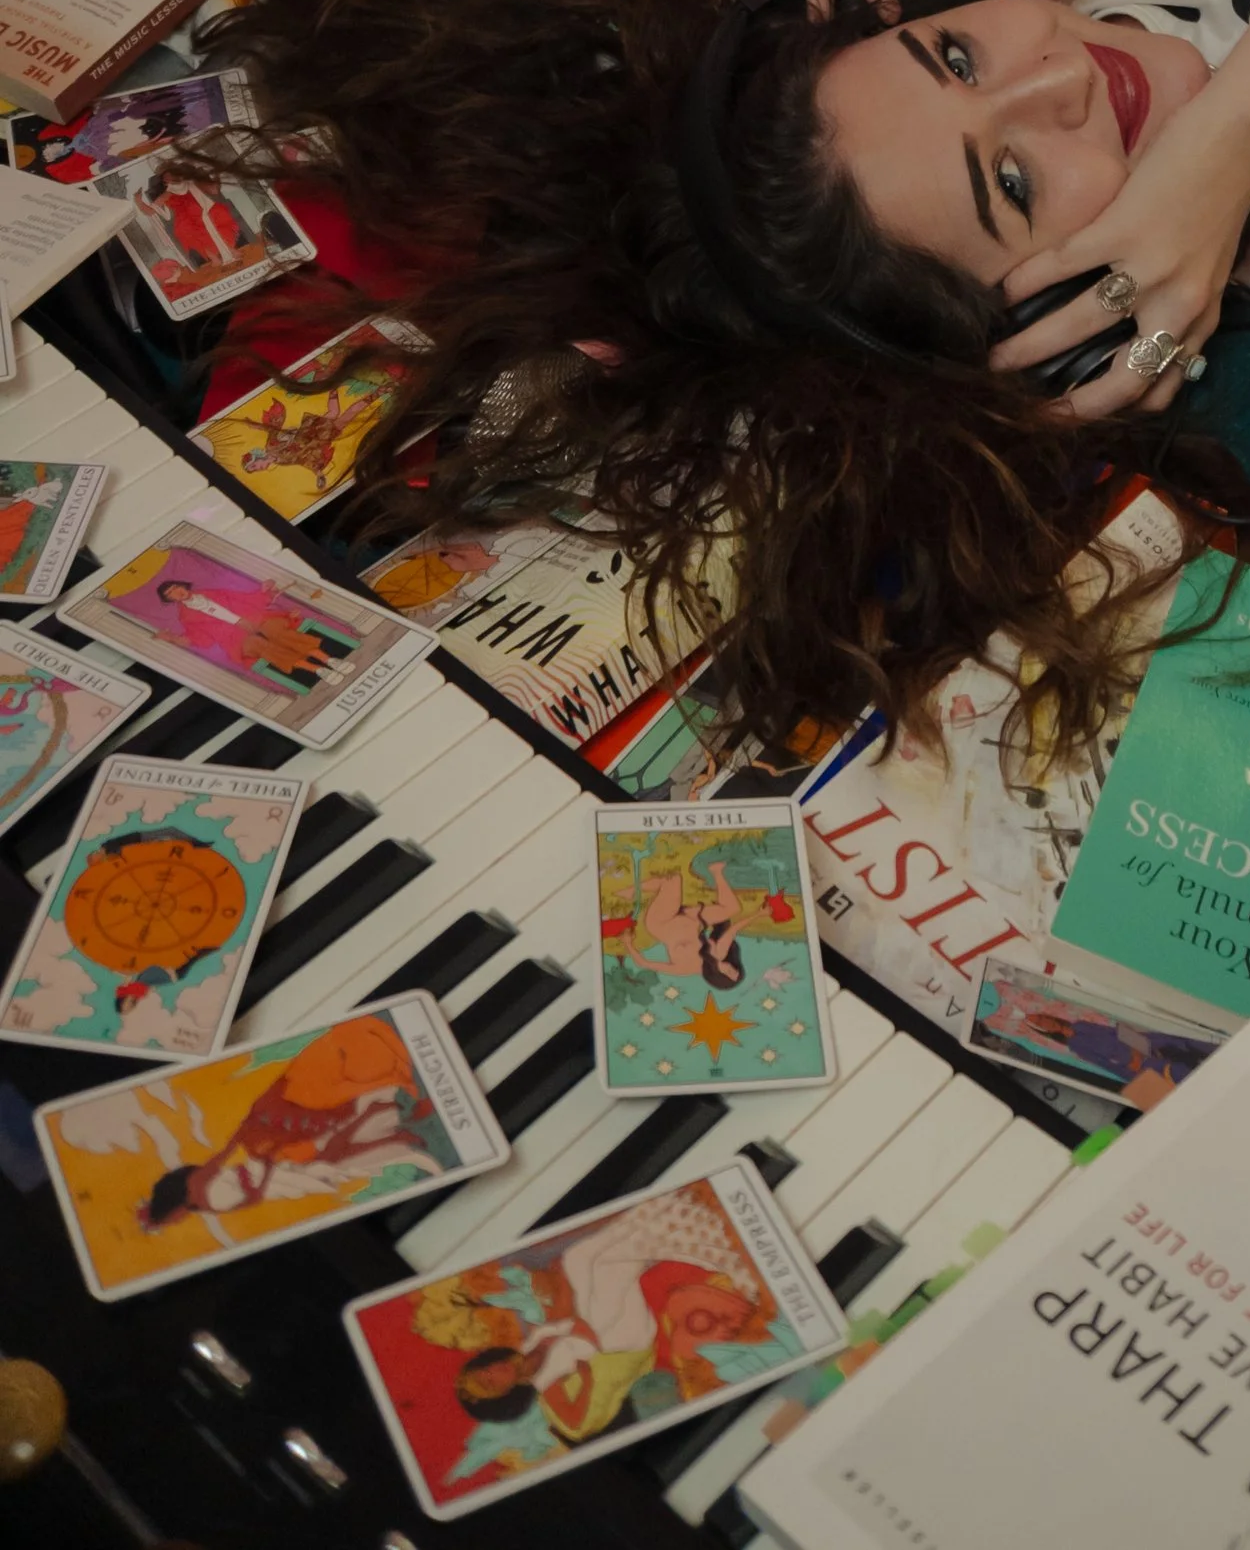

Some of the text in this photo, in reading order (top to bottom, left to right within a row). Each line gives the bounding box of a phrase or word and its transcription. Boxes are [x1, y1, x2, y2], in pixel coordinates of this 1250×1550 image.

[4, 29, 80, 72] MUSIC
[21, 62, 55, 87] THE
[89, 56, 113, 80] THE
[112, 23, 150, 61] MUSIC
[179, 248, 299, 308] THE HIEROPHNT
[31, 548, 61, 593] QUEEN
[59, 465, 96, 535] PENTACLES
[1127, 521, 1172, 562] TOSTI
[12, 639, 110, 695] THE WORLD
[335, 655, 396, 716] JUSTICE
[112, 765, 204, 789] FORTUNE
[228, 779, 292, 799] WHEEL
[641, 811, 746, 829] THE STAR
[1120, 852, 1175, 888] for
[410, 1028, 473, 1135] STRENGTH
[1119, 1197, 1190, 1261] LIFE
[727, 1189, 817, 1328] THE EMPRESS
[1184, 1249, 1247, 1305] FOR
[1080, 1233, 1210, 1342] HABIT
[1027, 1288, 1231, 1456] THARP
